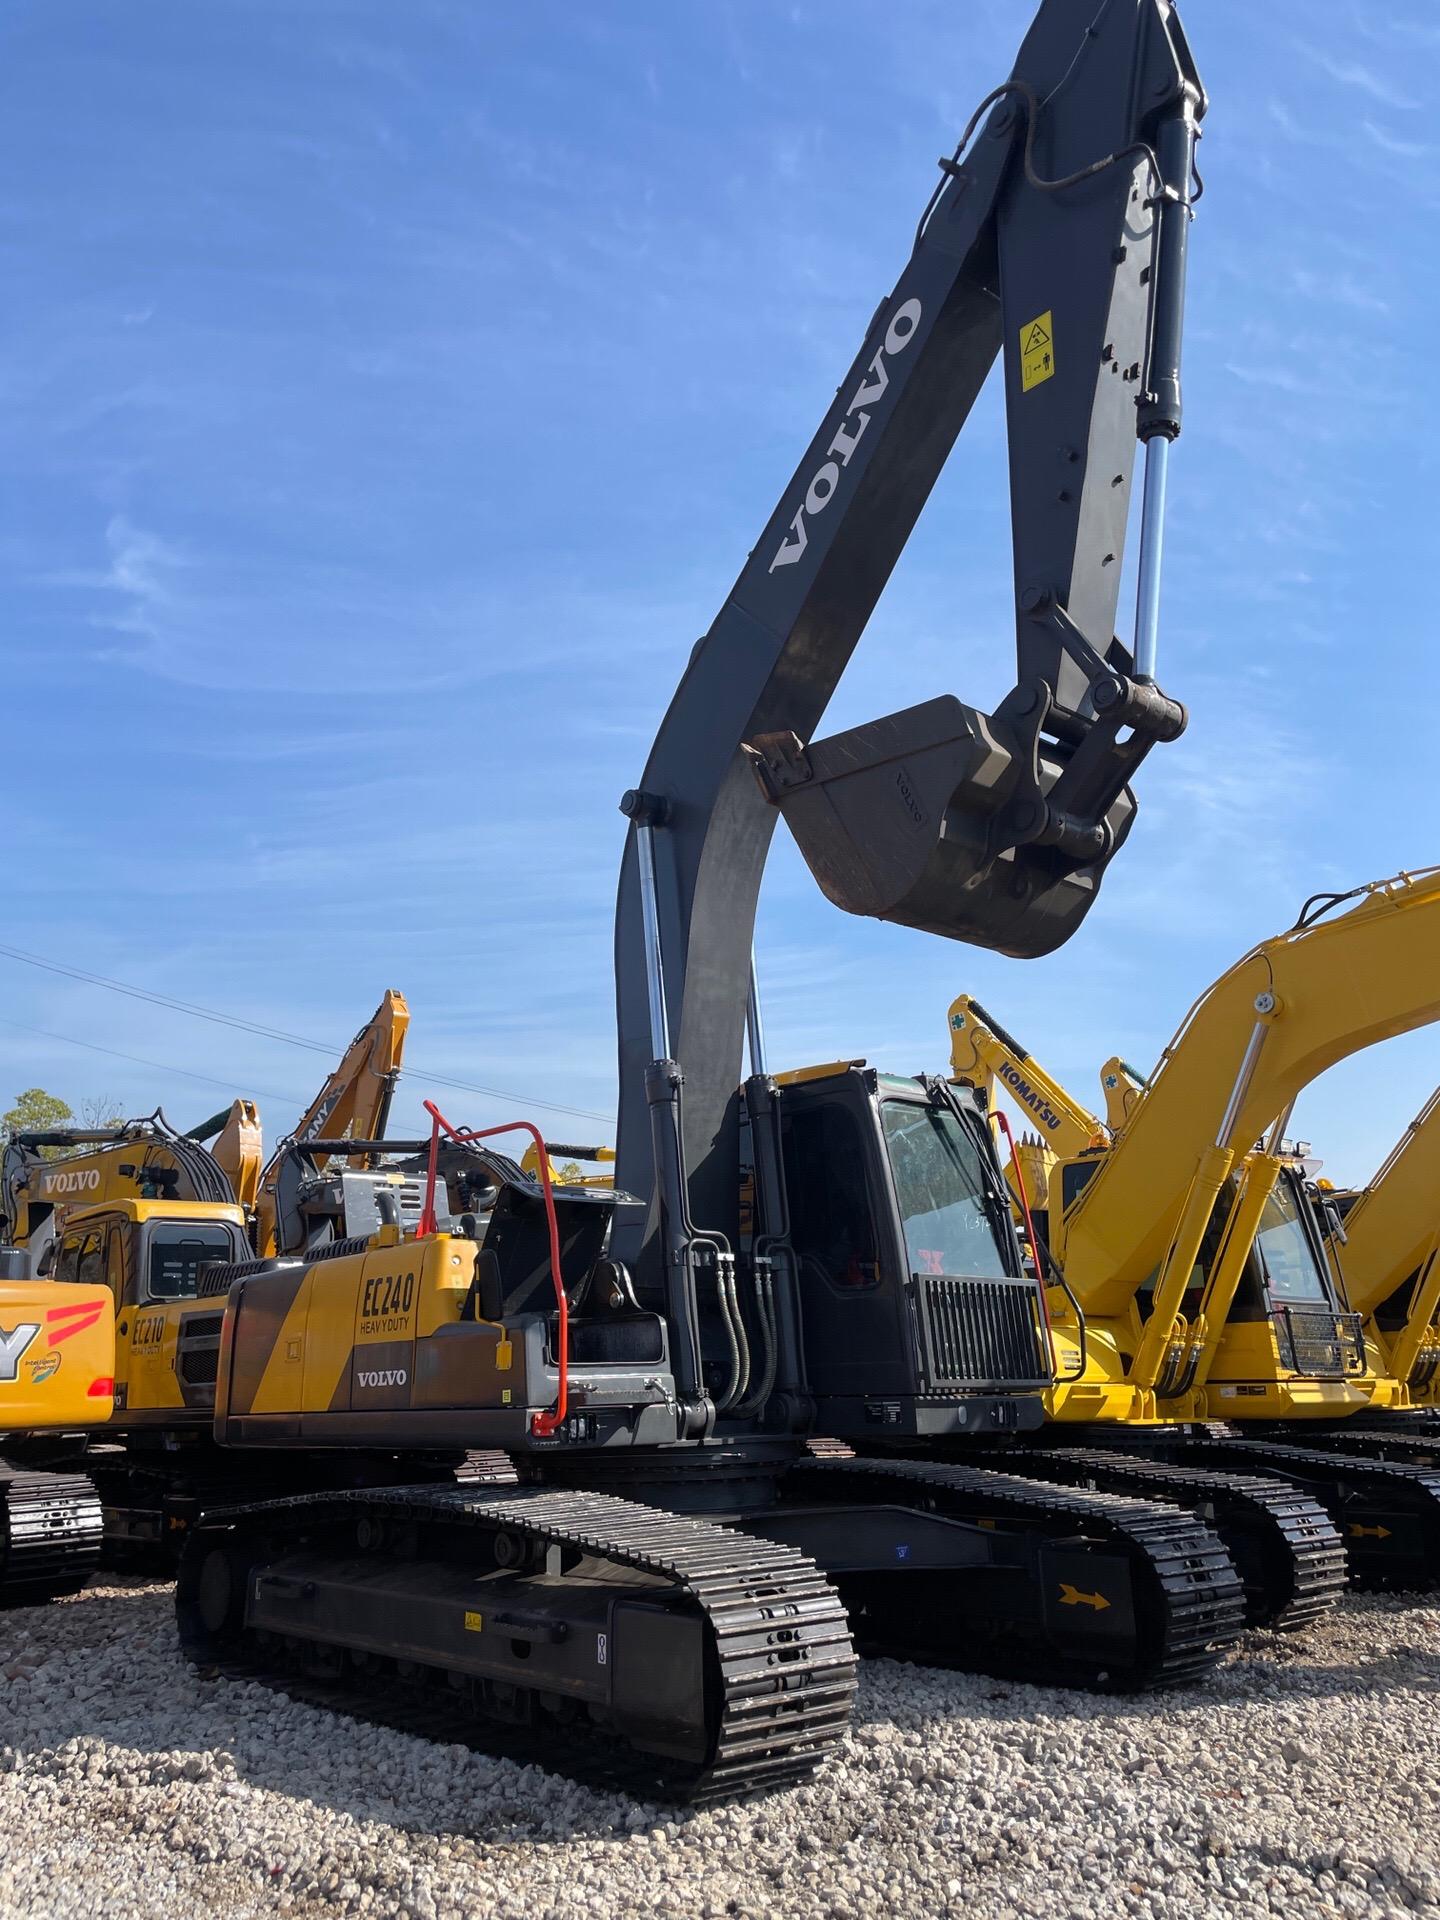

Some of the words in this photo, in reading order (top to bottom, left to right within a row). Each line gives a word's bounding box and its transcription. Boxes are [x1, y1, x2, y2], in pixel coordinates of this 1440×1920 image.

[768, 298, 922, 574] VOLVO
[999, 1061, 1061, 1130] KOMATSU
[304, 1101, 329, 1141] ANY
[45, 1169, 100, 1193] VOLVO
[362, 1272, 414, 1317] EC240
[132, 1316, 164, 1345] EC210
[358, 1369, 407, 1388] VOLVO
